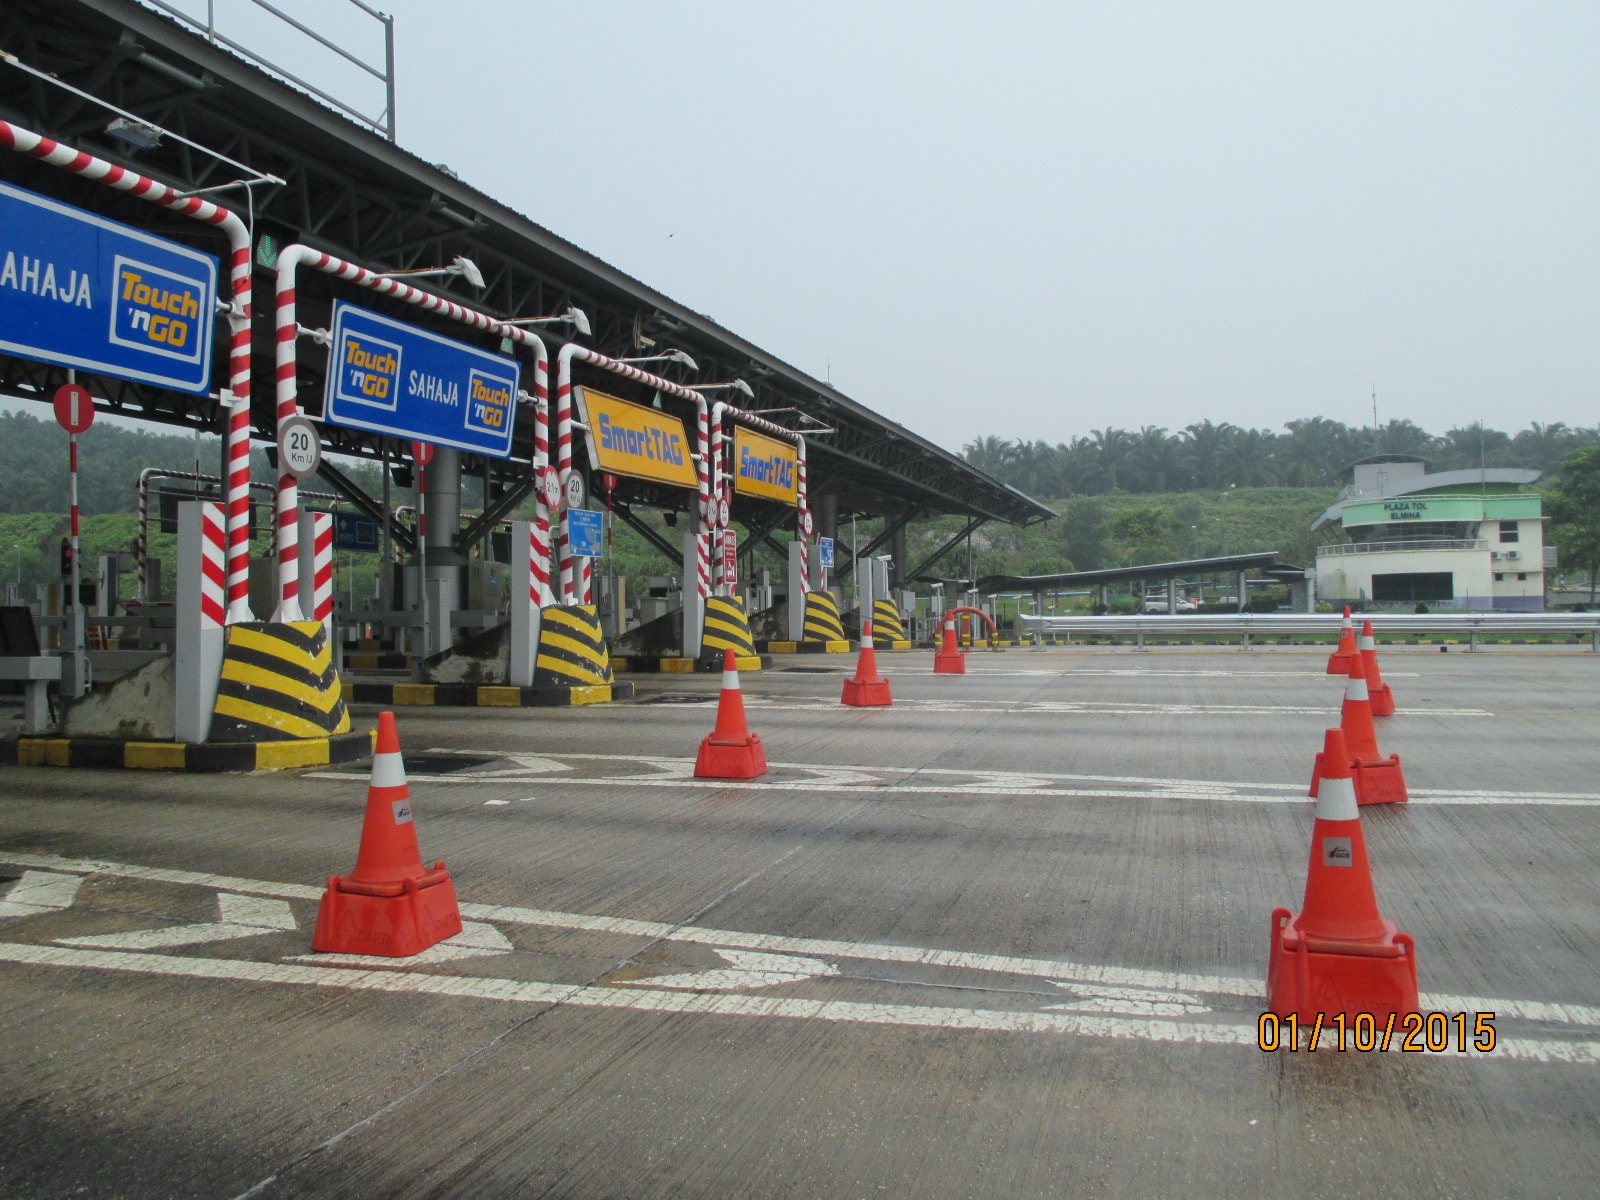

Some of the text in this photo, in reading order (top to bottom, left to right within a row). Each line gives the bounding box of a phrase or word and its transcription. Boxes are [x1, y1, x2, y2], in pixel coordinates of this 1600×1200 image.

[1, 252, 92, 309] AHAJA
[122, 271, 198, 319] Touch
[346, 341, 397, 375] Touch
[408, 369, 459, 407] SAHAJA
[472, 379, 509, 407] Touch
[291, 432, 309, 451] 20
[570, 480, 580, 493] 20
[1384, 502, 1427, 511] PLAZA TOL
[1391, 511, 1421, 520] ELMINA
